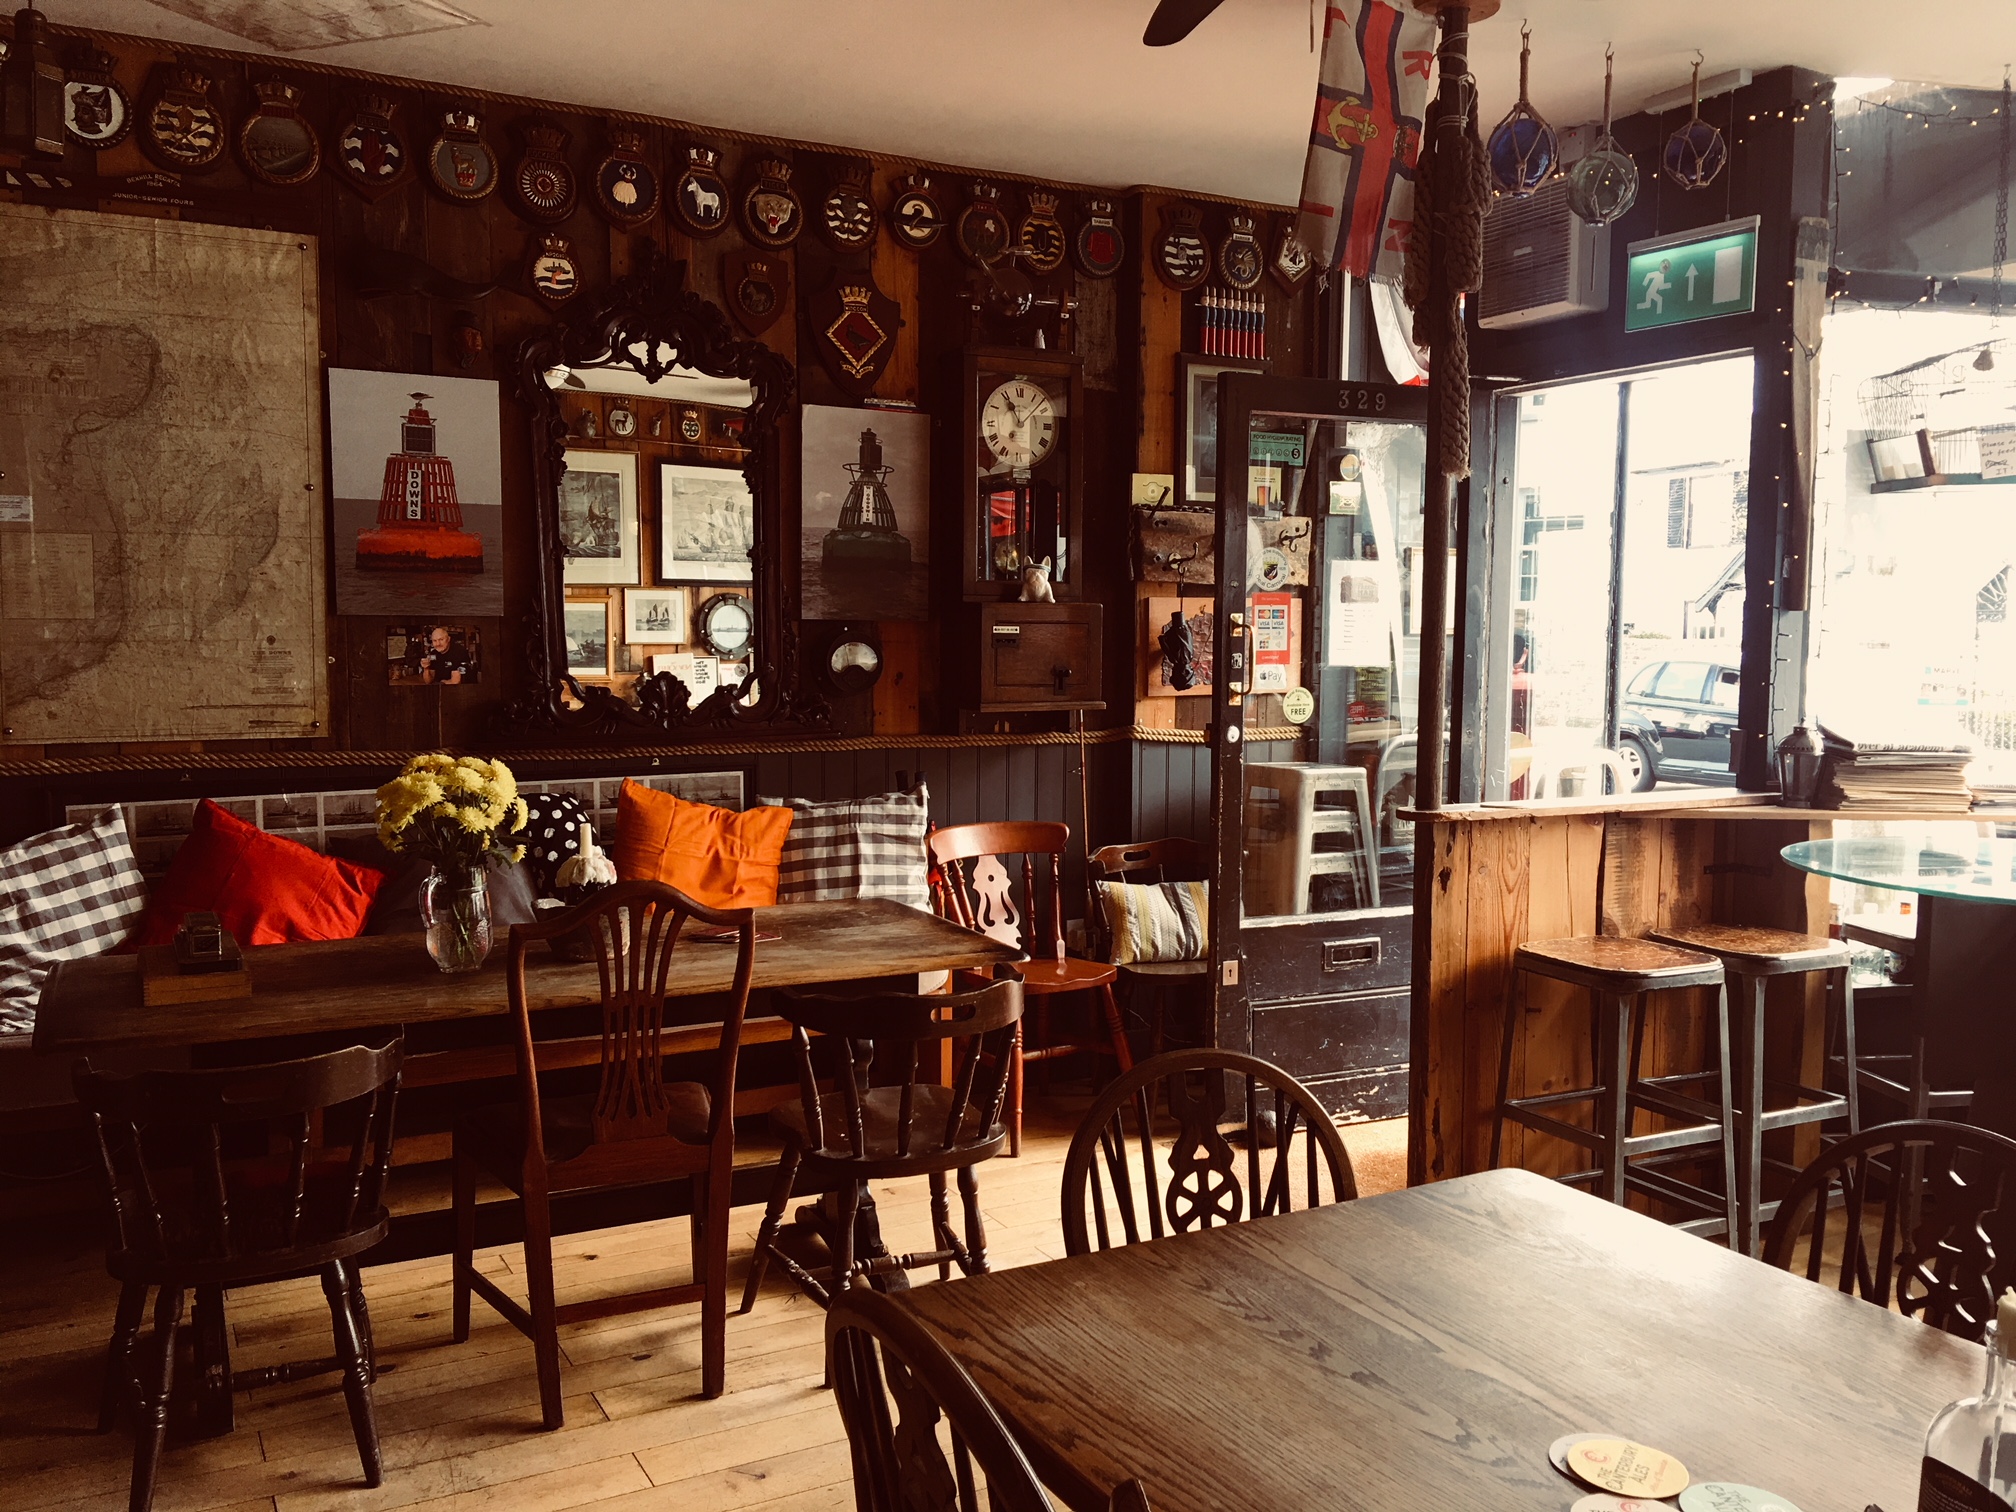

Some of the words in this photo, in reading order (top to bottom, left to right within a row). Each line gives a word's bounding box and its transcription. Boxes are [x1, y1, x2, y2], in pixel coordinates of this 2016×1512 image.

[1402, 50, 1433, 80] R
[358, 116, 388, 127] ULSTER
[126, 174, 153, 184] BEXHILL
[154, 173, 181, 188] REGATTA
[764, 180, 786, 190] TIGER
[112, 192, 168, 203] JUNIOR-SENIOR
[170, 198, 194, 206] FOURS
[1338, 389, 1387, 412] 329
[1981, 440, 2005, 449] Please
[1997, 446, 2016, 456] feed
[408, 471, 421, 518] DOWNS
[1266, 573, 1287, 588] Carnival
[1267, 670, 1283, 683] Pay
[1290, 707, 1307, 716] FREE
[1597, 1466, 1613, 1480] THE
[1605, 1443, 1639, 1491] CANTERBURY
[1627, 1463, 1651, 1485] ALES
